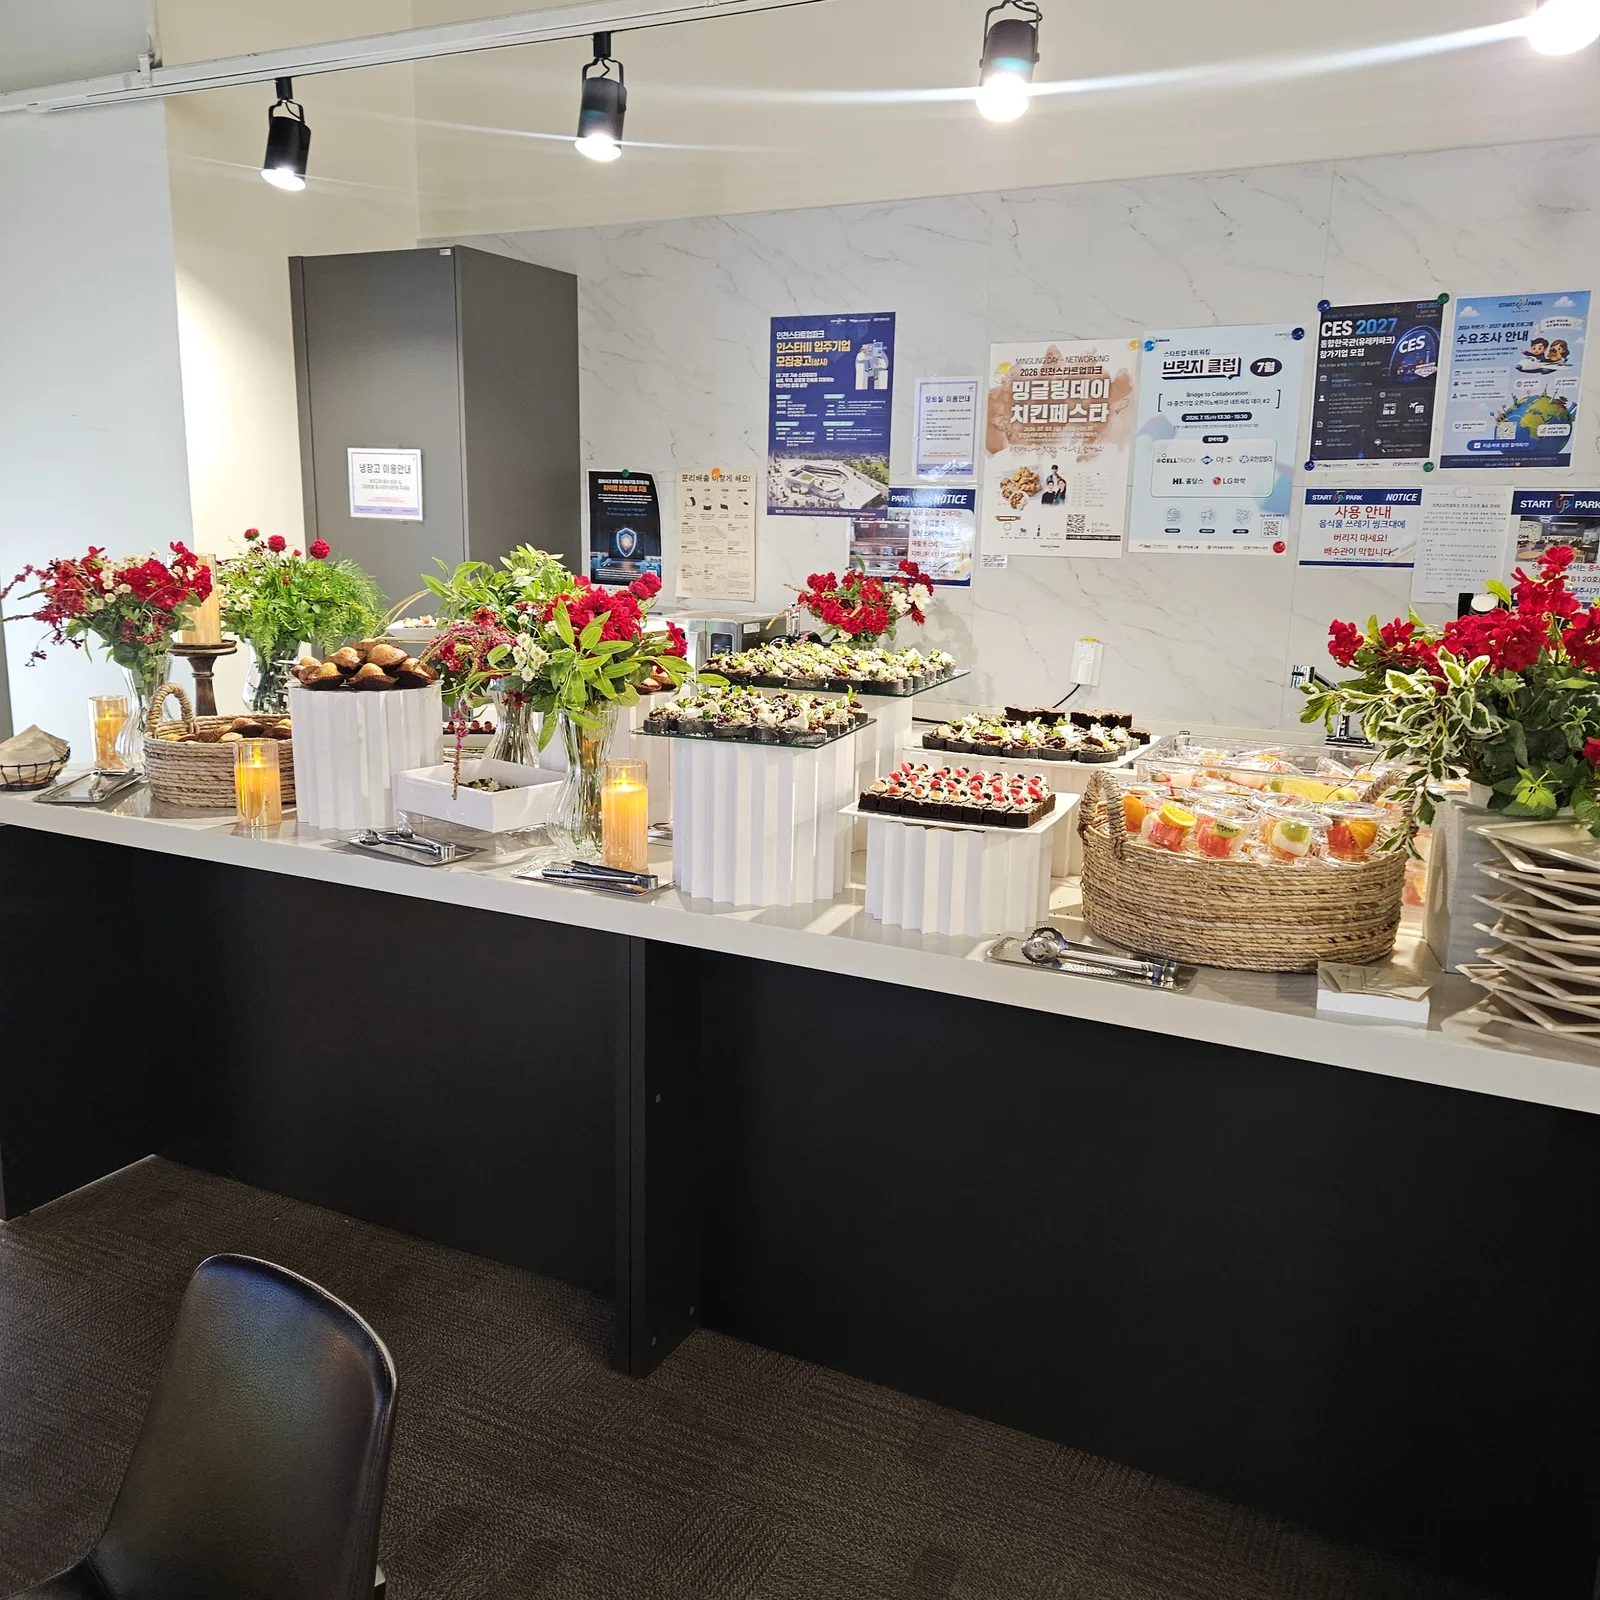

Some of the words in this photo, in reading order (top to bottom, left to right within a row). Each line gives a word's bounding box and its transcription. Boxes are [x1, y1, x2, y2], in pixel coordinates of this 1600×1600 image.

[1321, 321, 1353, 337] CES
[1356, 318, 1398, 335] 2027
[1457, 332, 1502, 345] 수요조사
[1505, 331, 1529, 342] 안내
[814, 340, 851, 352] 입주기업
[1399, 336, 1426, 354] CES
[1350, 349, 1365, 357] 모집
[1065, 355, 1110, 364] NETWORKING
[1020, 368, 1038, 377] 2026
[1040, 366, 1103, 376] 인천스타트업파크
[1162, 360, 1203, 375] 브릿지
[1208, 358, 1236, 373] 클럽
[1257, 362, 1275, 373] 7월
[1012, 379, 1110, 400] 밍글링데이
[946, 395, 971, 403] 이용안내
[1010, 403, 1110, 424] 치킨페스타
[359, 464, 380, 474] 냉장고
[383, 464, 411, 475] 이용안내
[735, 475, 751, 483] 해요!
[934, 495, 968, 504] NOTICE
[1386, 494, 1418, 502] NOTICE
[1335, 506, 1361, 520] 사용
[1366, 506, 1392, 519] 안내
[1319, 520, 1343, 528] 음식물
[1345, 520, 1370, 528] 쓰레기
[1334, 534, 1358, 542] 버리지
[1360, 534, 1388, 542] 마세요!
[1324, 547, 1356, 556] 배수관이
